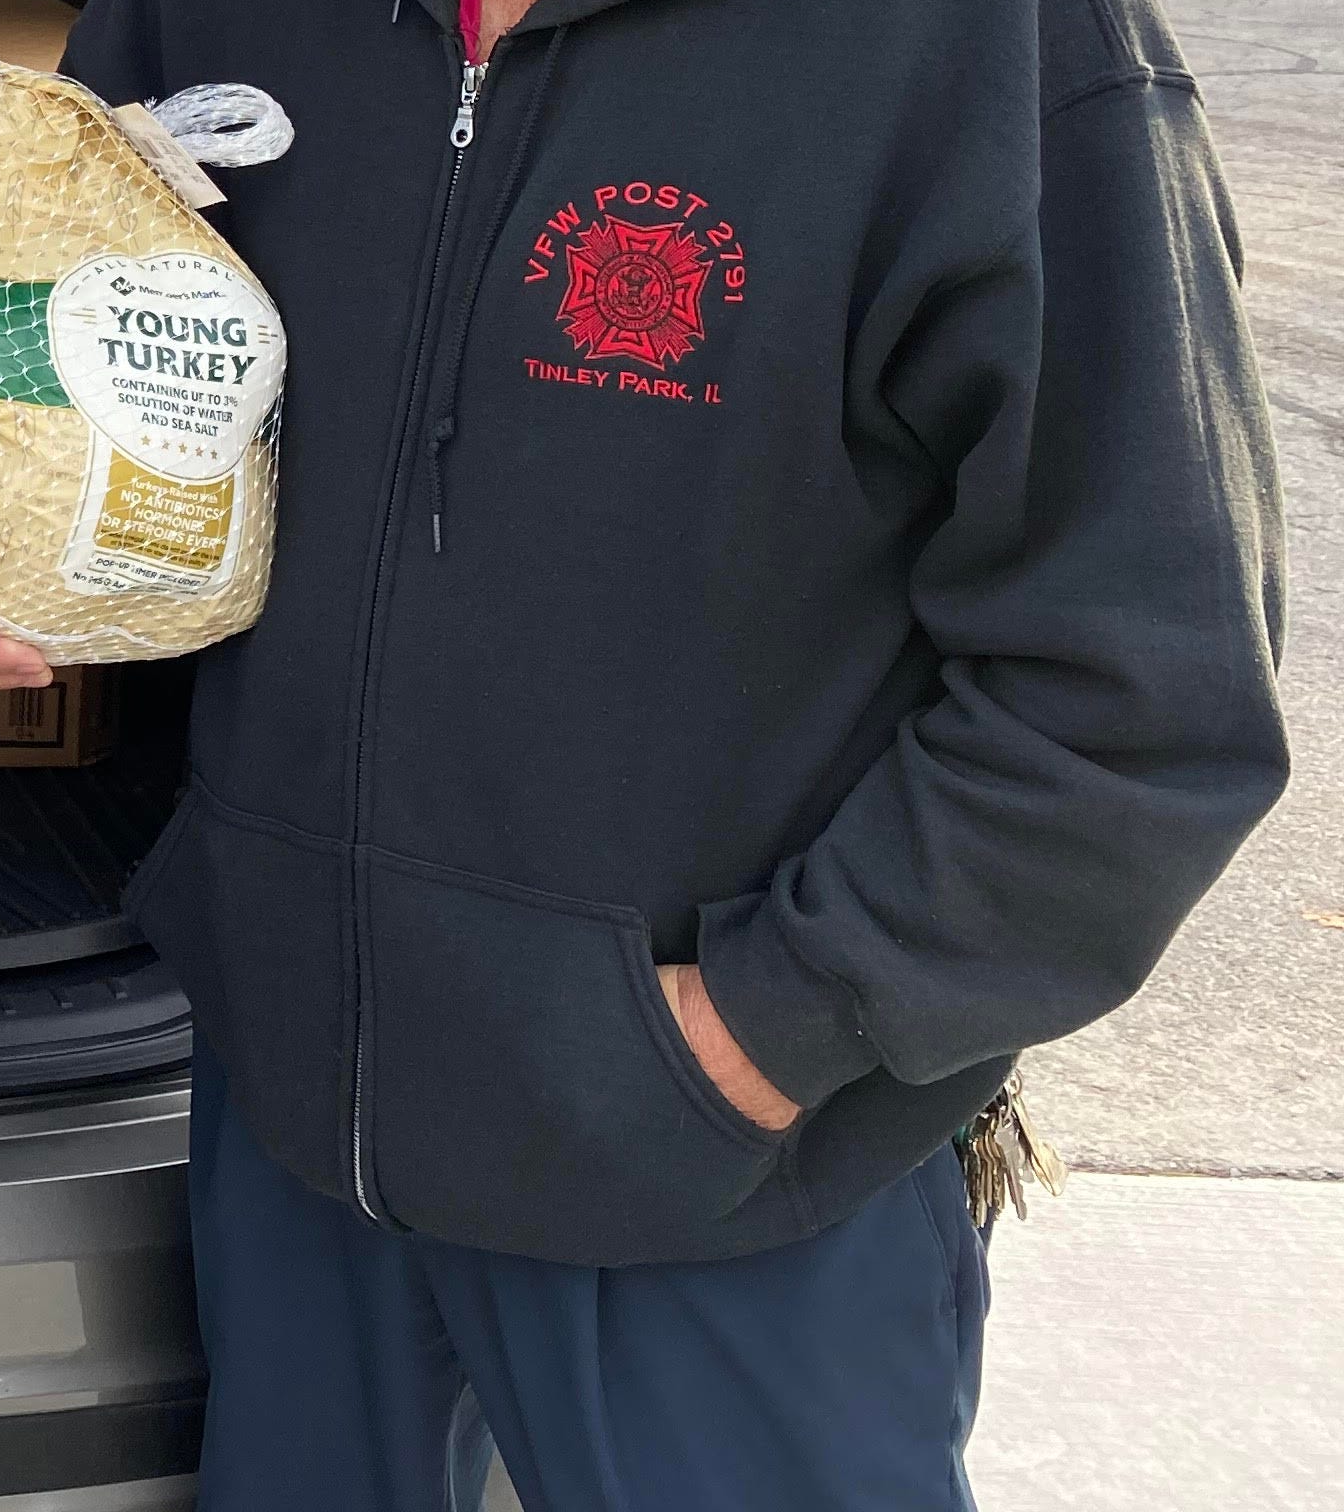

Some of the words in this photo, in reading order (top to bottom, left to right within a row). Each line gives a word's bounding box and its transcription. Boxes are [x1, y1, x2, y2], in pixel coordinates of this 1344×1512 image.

[524, 202, 581, 284] VFW
[594, 182, 709, 219] POST
[706, 221, 746, 303] 2791
[94, 259, 127, 276] ALL
[106, 304, 248, 348] YOUNG
[98, 337, 258, 386] TURKEY
[112, 376, 189, 402] CONTAINING
[206, 393, 222, 406] TO
[223, 395, 239, 408] 3%
[524, 358, 609, 387] TINLEY
[619, 371, 694, 403] PARK,
[705, 384, 722, 404] IL
[118, 392, 180, 414] SOLUTION
[182, 404, 196, 416] OF
[197, 407, 233, 424] WATER
[141, 412, 169, 427] AND
[171, 418, 193, 431] SEA
[194, 422, 219, 437] SALT
[120, 490, 142, 503] NO
[101, 514, 121, 529] OR
[124, 519, 185, 544] STEROIDS
[135, 507, 206, 533] HORMONES
